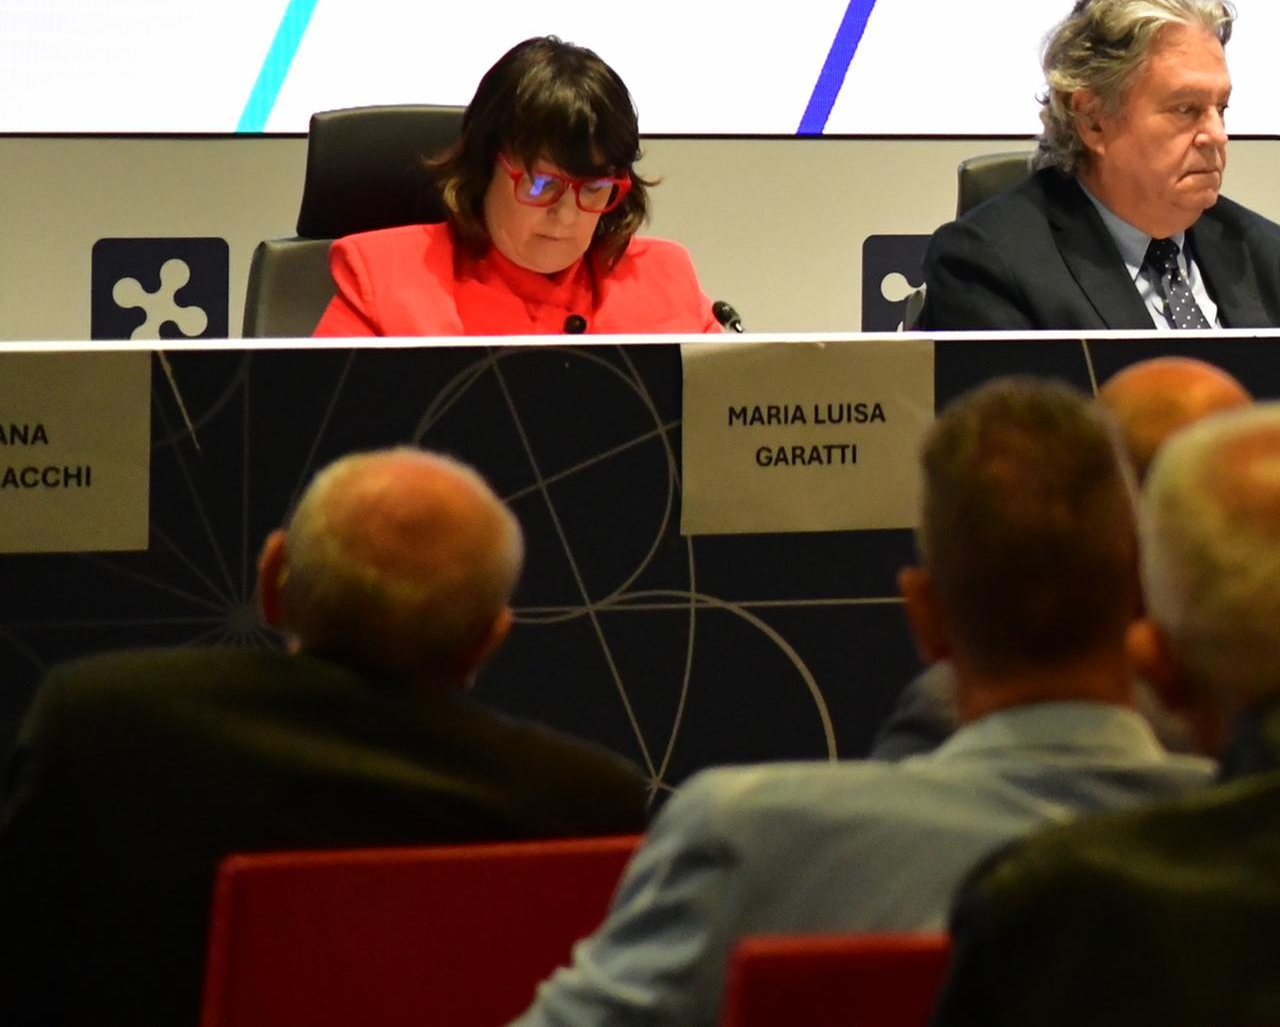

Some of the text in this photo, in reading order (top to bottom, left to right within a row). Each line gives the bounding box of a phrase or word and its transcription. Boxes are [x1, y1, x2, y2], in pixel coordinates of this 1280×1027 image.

[727, 402, 887, 427] MARIA LUISA
[755, 443, 857, 468] GARATTI
[1, 466, 91, 488] ACCHI
